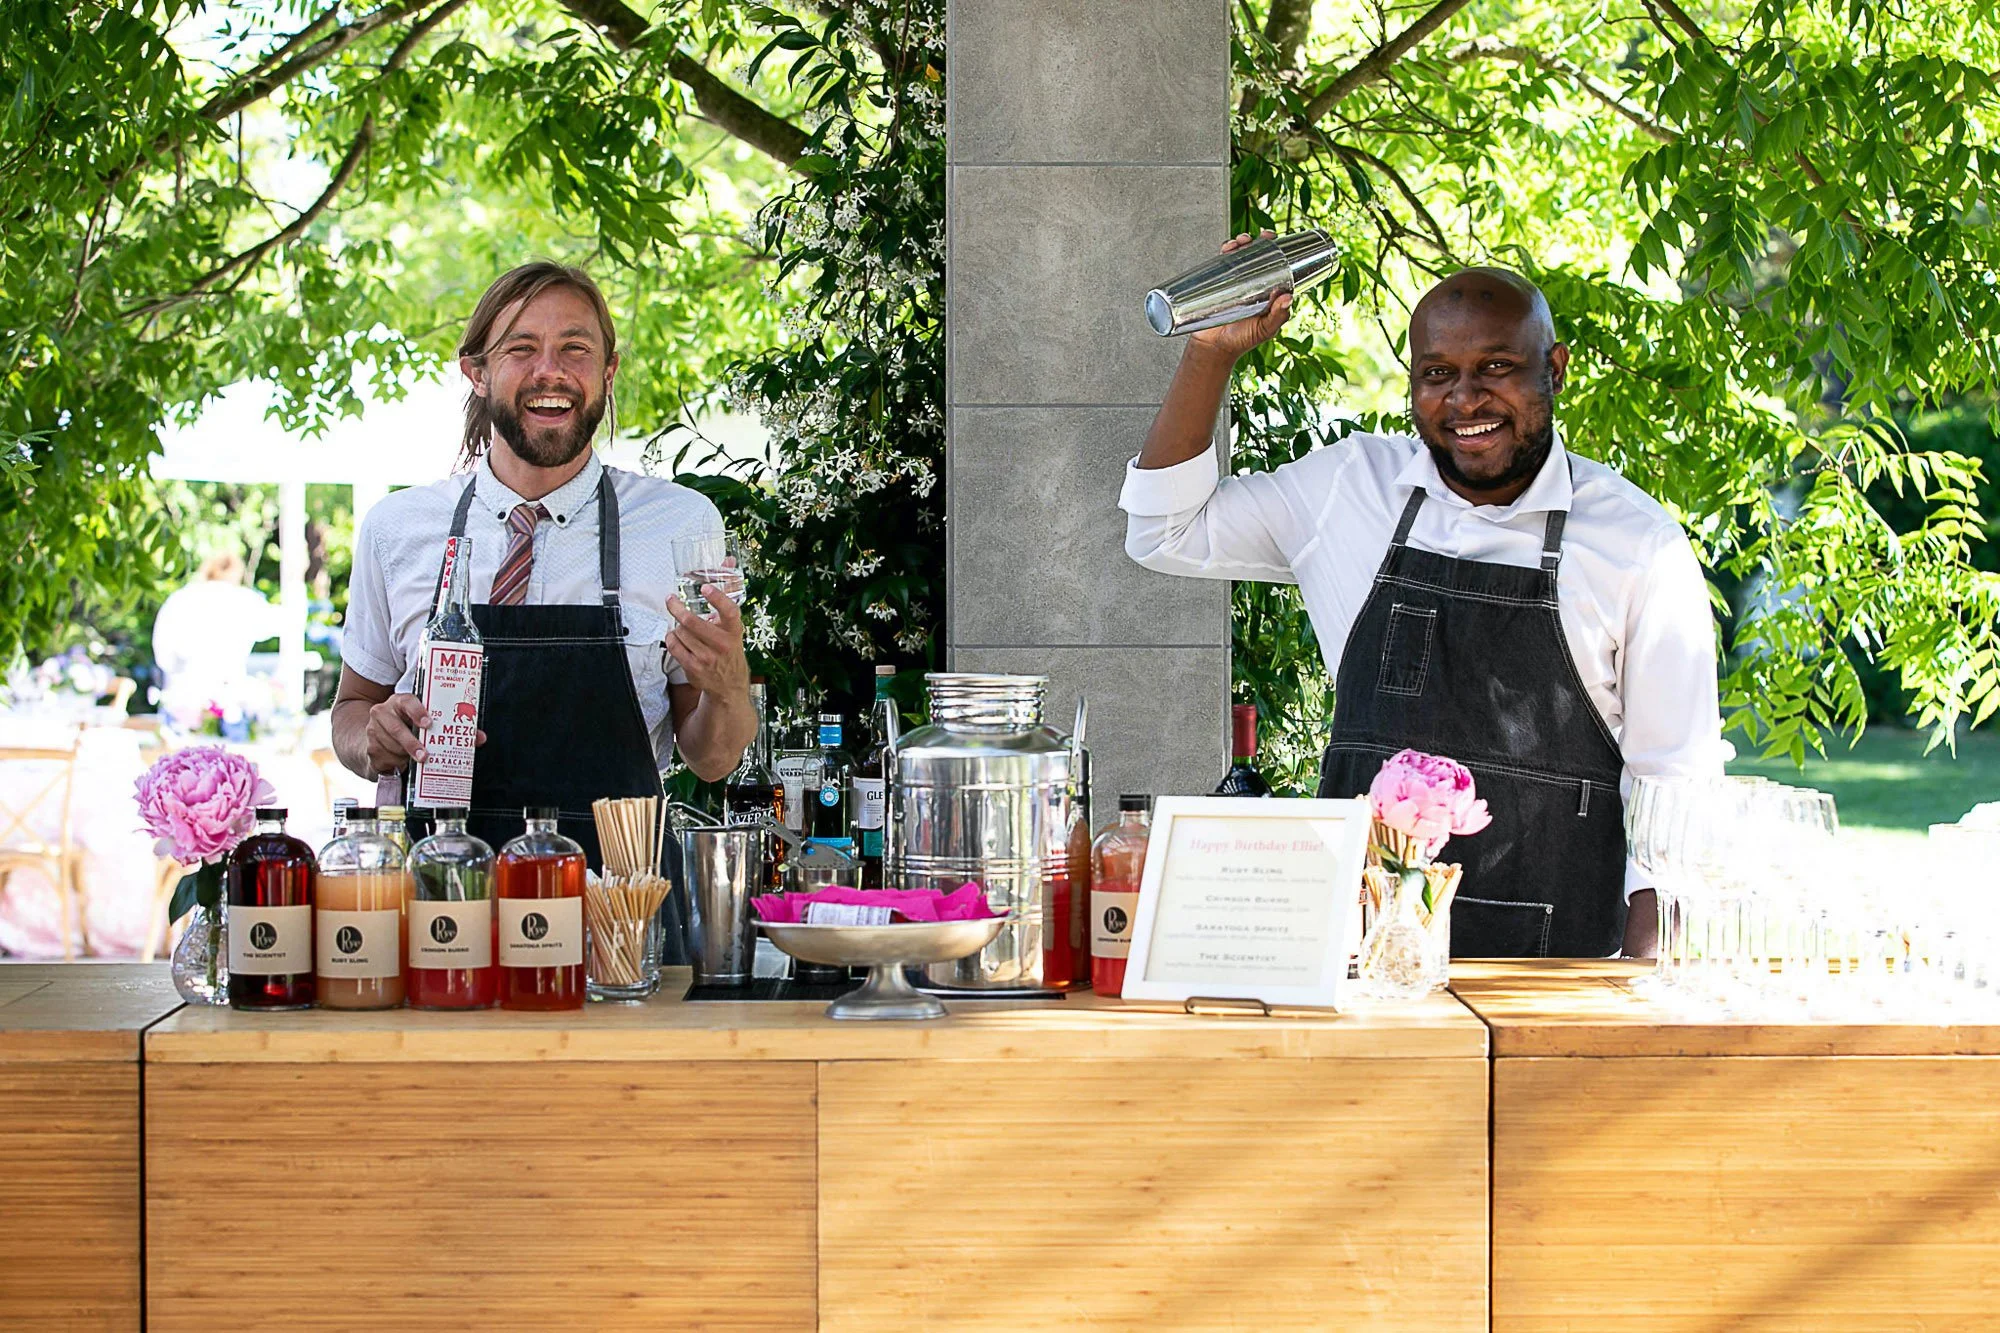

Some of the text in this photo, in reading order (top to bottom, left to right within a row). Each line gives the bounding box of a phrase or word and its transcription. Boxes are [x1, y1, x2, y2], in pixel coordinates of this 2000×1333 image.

[866, 791, 884, 800] GLE
[1190, 839, 1229, 854] Happy
[1234, 839, 1288, 854] Birthday
[1223, 954, 1278, 962] SCIENTIST
